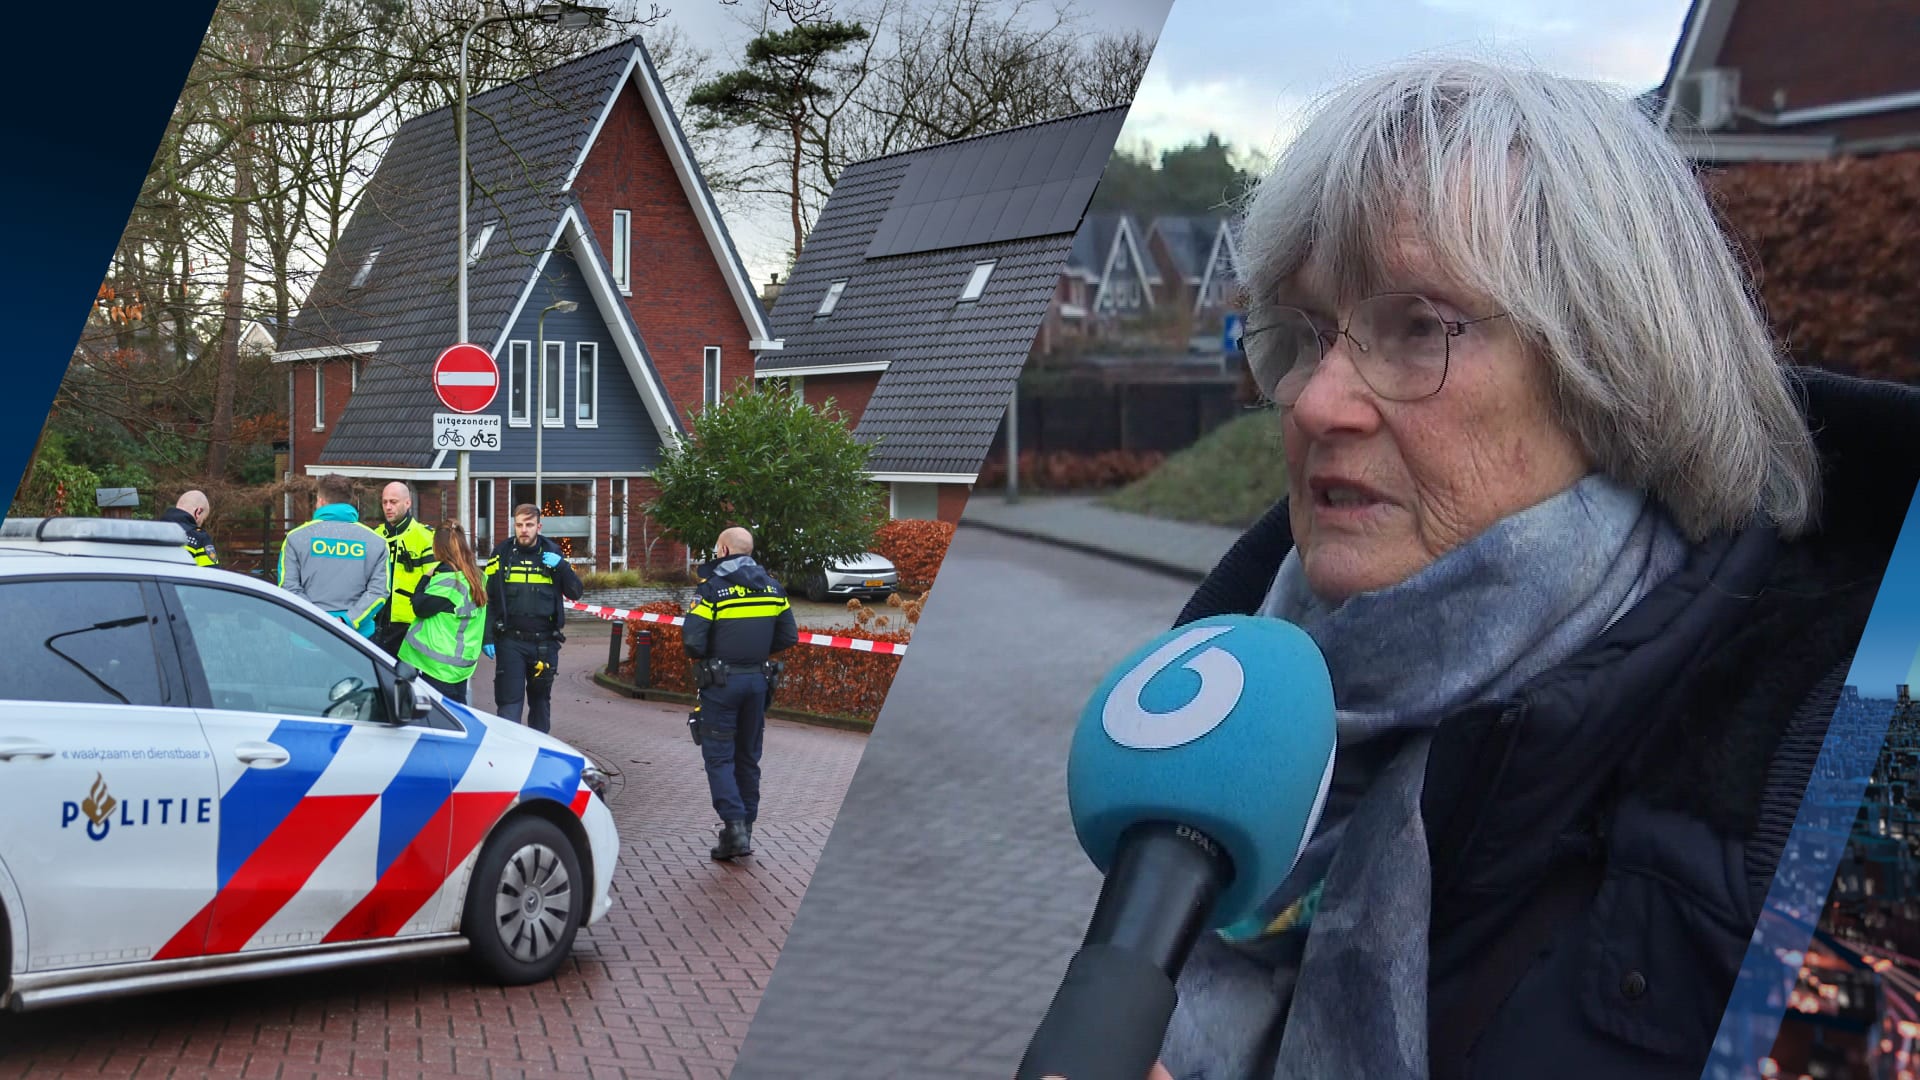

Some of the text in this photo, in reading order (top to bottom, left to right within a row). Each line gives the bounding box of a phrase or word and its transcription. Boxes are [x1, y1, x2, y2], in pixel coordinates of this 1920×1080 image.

[437, 417, 498, 426] uitgezonderd
[312, 540, 365, 557] OvDG
[1102, 625, 1245, 750] 6
[72, 748, 131, 761] waakzaam
[132, 750, 146, 759] en
[147, 747, 202, 760] dienstbaar
[61, 798, 212, 842] POLITIE
